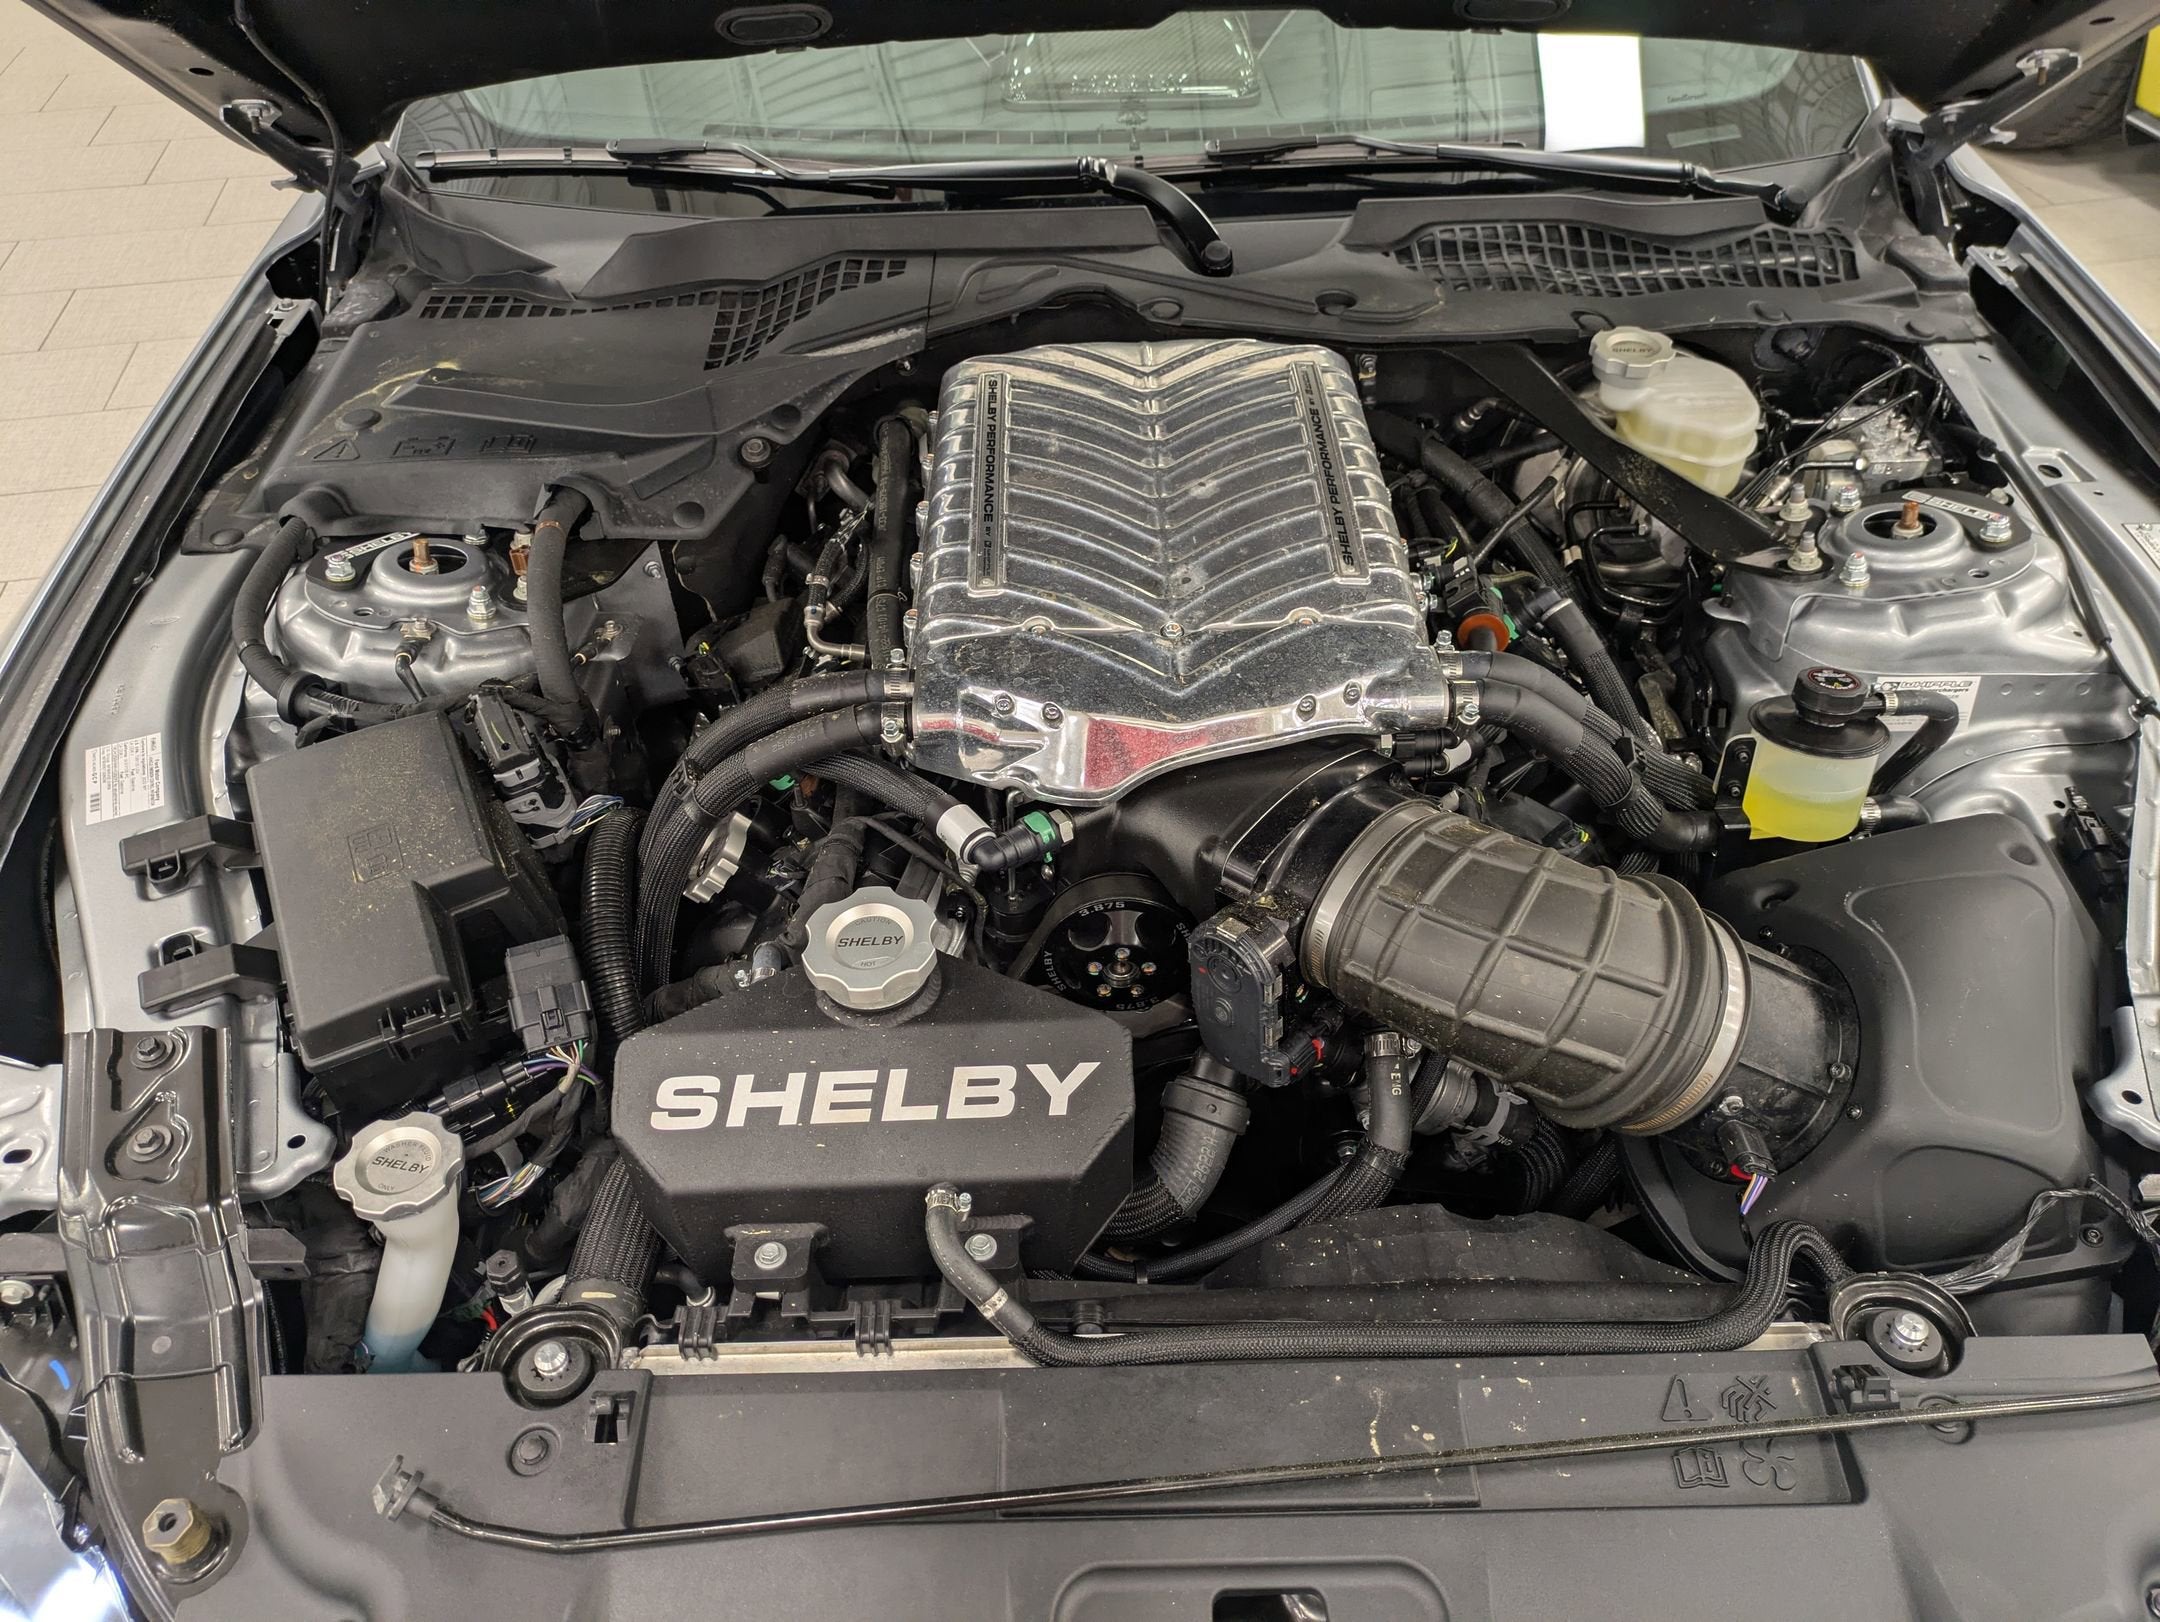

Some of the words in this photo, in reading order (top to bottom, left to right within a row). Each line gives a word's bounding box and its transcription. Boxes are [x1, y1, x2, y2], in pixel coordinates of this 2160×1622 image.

[988, 380, 998, 421] SHELBY
[1311, 407, 1341, 505] PERFORMANCE
[983, 423, 997, 523] PERFORMANCE
[985, 526, 991, 536] BY
[1332, 506, 1354, 567] SHELBY
[1900, 680, 1973, 689] WHIPPLE
[1079, 901, 1126, 917] 3.875
[854, 916, 892, 925] CAUTION
[837, 935, 904, 948] SHELBY
[1044, 950, 1067, 992] SHELBY
[650, 1062, 1101, 1130] SHELBY
[383, 1141, 419, 1153] WASHER
[420, 1144, 432, 1162] FLUID
[371, 1156, 430, 1174] SHELBY
[378, 1183, 395, 1191] ONLY
